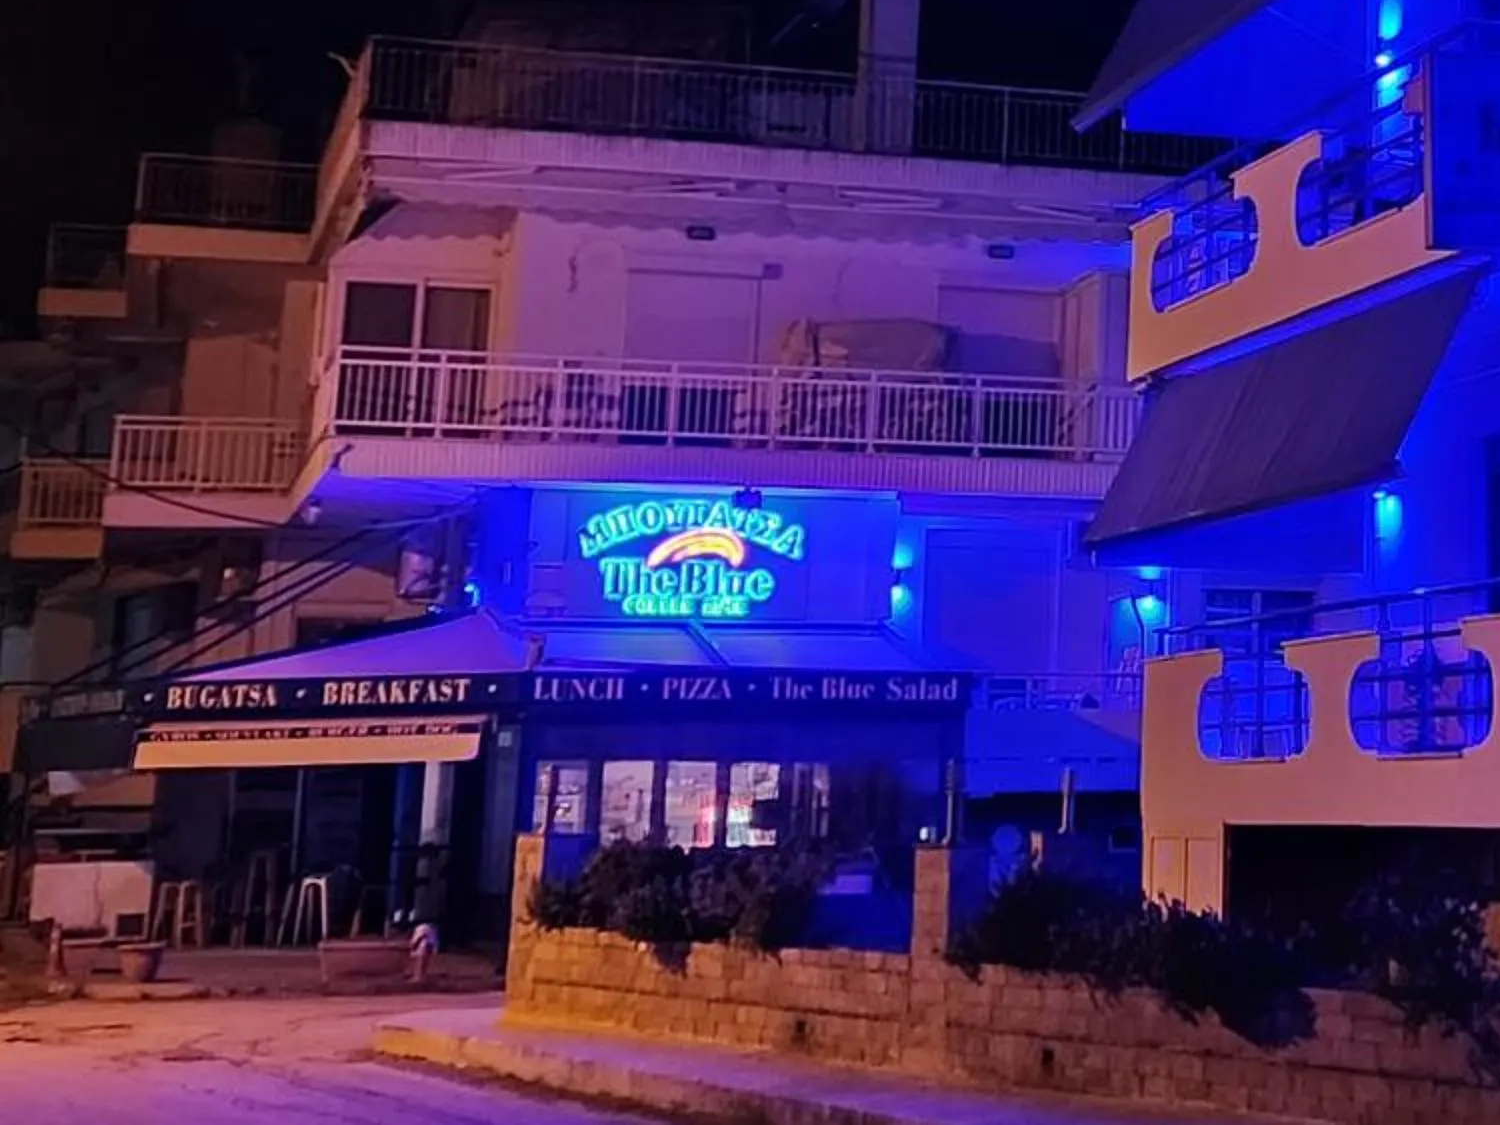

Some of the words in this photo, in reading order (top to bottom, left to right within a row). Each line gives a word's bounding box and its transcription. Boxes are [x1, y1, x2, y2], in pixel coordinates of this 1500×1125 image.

[600, 556, 679, 600] The
[679, 558, 775, 601] Blue
[166, 681, 277, 710] BUGATSA
[322, 678, 471, 706] BREAKFAST
[533, 676, 625, 702] LUNCH
[662, 677, 732, 701] PIZZA
[769, 676, 814, 701] The
[822, 676, 876, 701] Blue
[886, 676, 959, 702] Salad
